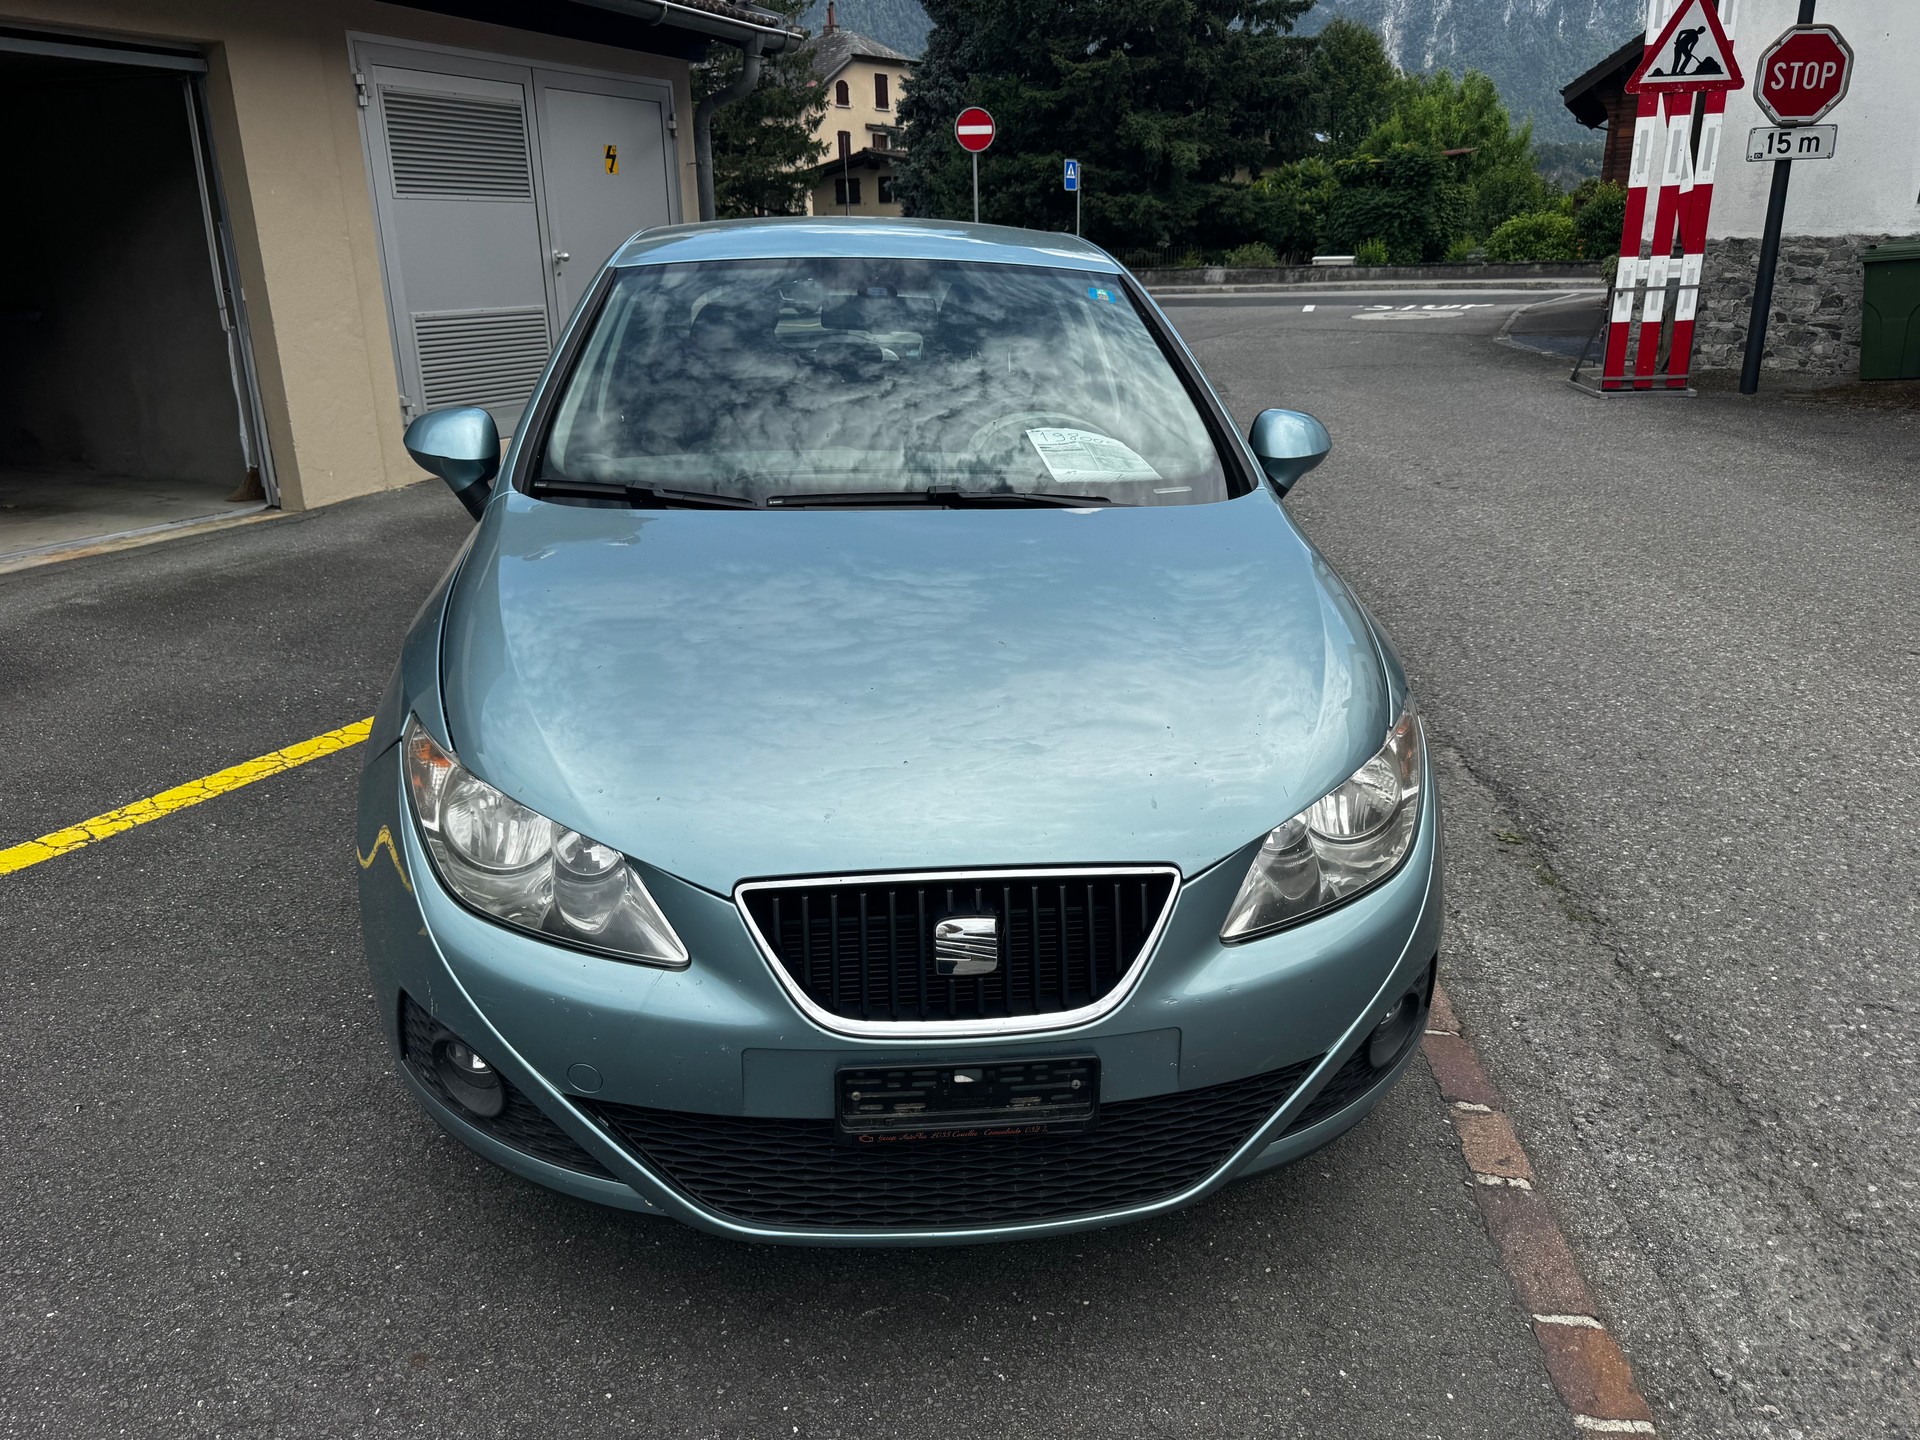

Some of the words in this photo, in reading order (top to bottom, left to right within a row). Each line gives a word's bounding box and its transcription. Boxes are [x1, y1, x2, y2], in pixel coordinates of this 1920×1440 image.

[1770, 61, 1837, 91] STOP
[1767, 131, 1792, 155] 15
[1798, 136, 1821, 153] m
